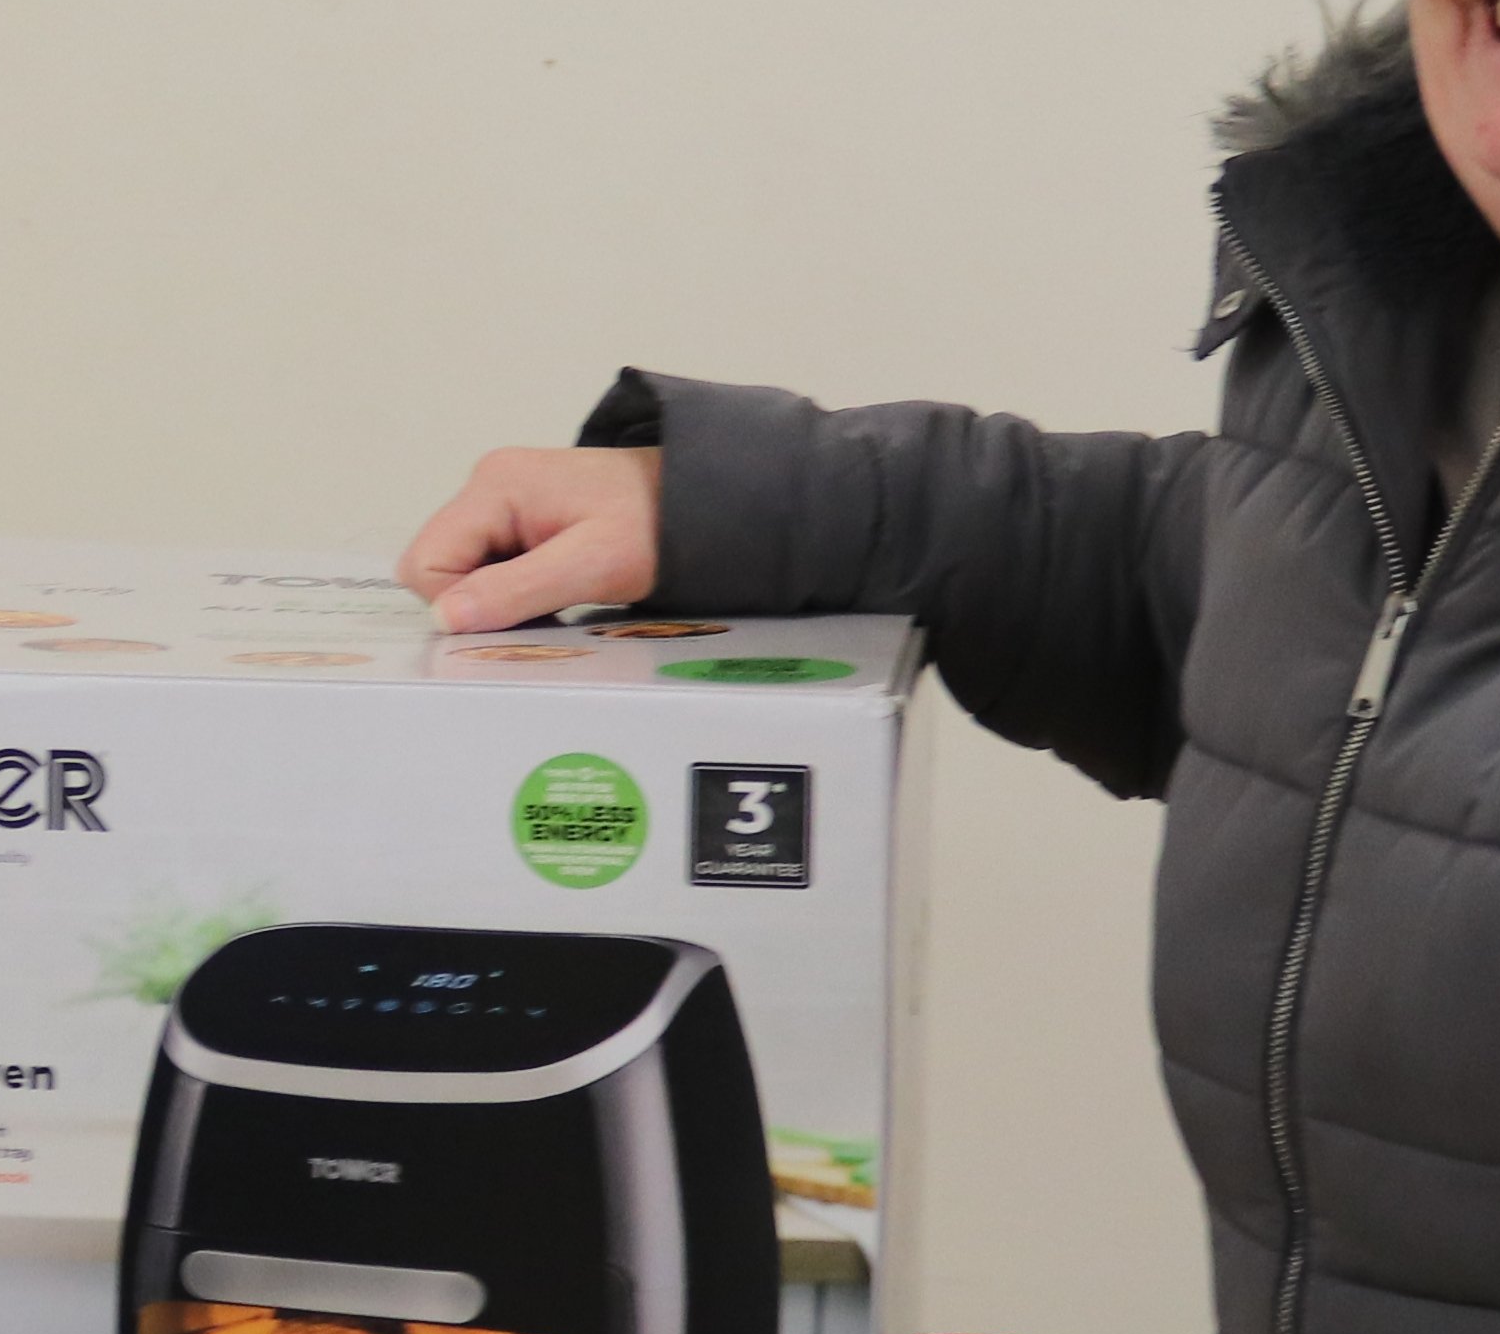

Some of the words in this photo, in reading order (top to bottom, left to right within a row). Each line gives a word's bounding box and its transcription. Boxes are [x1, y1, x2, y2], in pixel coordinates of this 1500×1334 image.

[208, 574, 412, 590] TOW
[530, 823, 629, 842] ENERGY
[724, 843, 777, 857] YEAR
[695, 861, 803, 877] GUARANTEE
